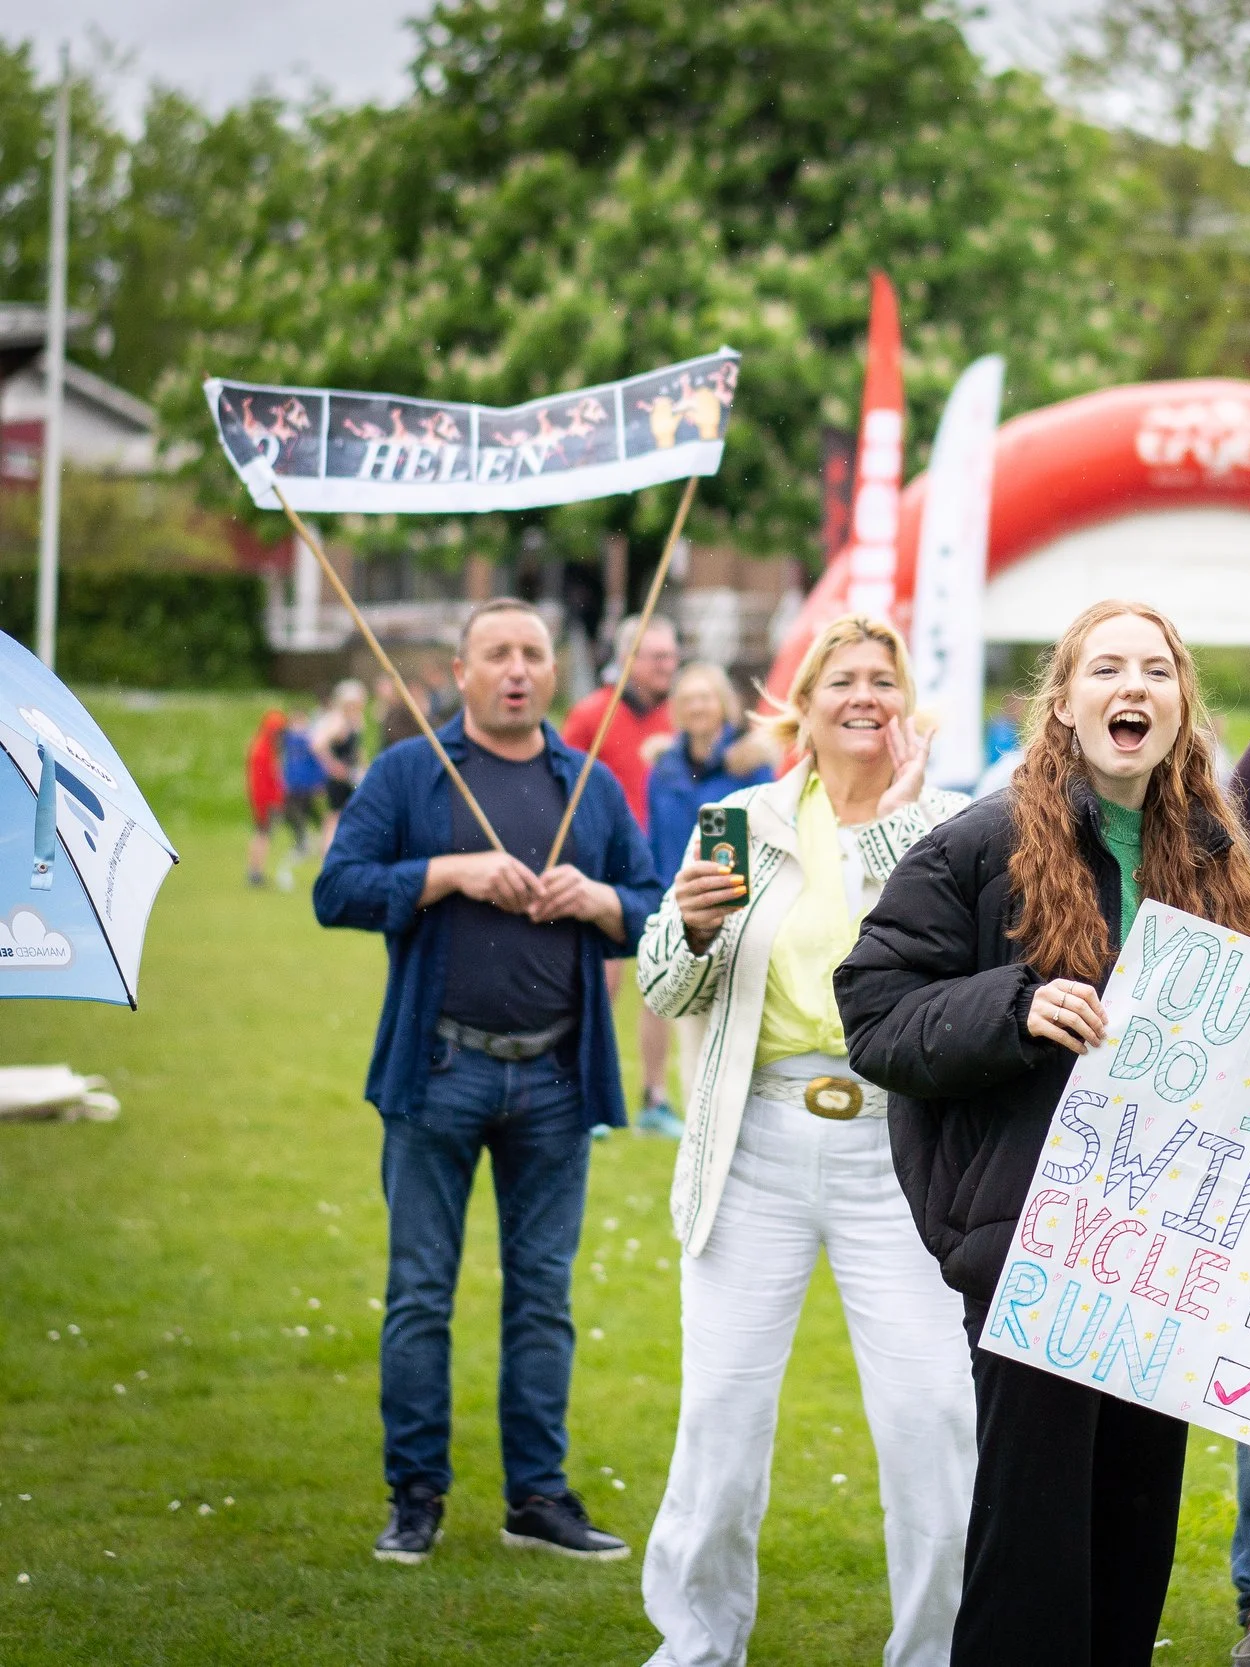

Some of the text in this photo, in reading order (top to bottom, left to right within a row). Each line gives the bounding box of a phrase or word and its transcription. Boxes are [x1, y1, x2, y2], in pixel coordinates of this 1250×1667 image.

[358, 441, 551, 483] HELEN
[1110, 1015, 1208, 1104] DO
[1020, 1188, 1232, 1321] CYCLE
[988, 1260, 1182, 1402] RUN
